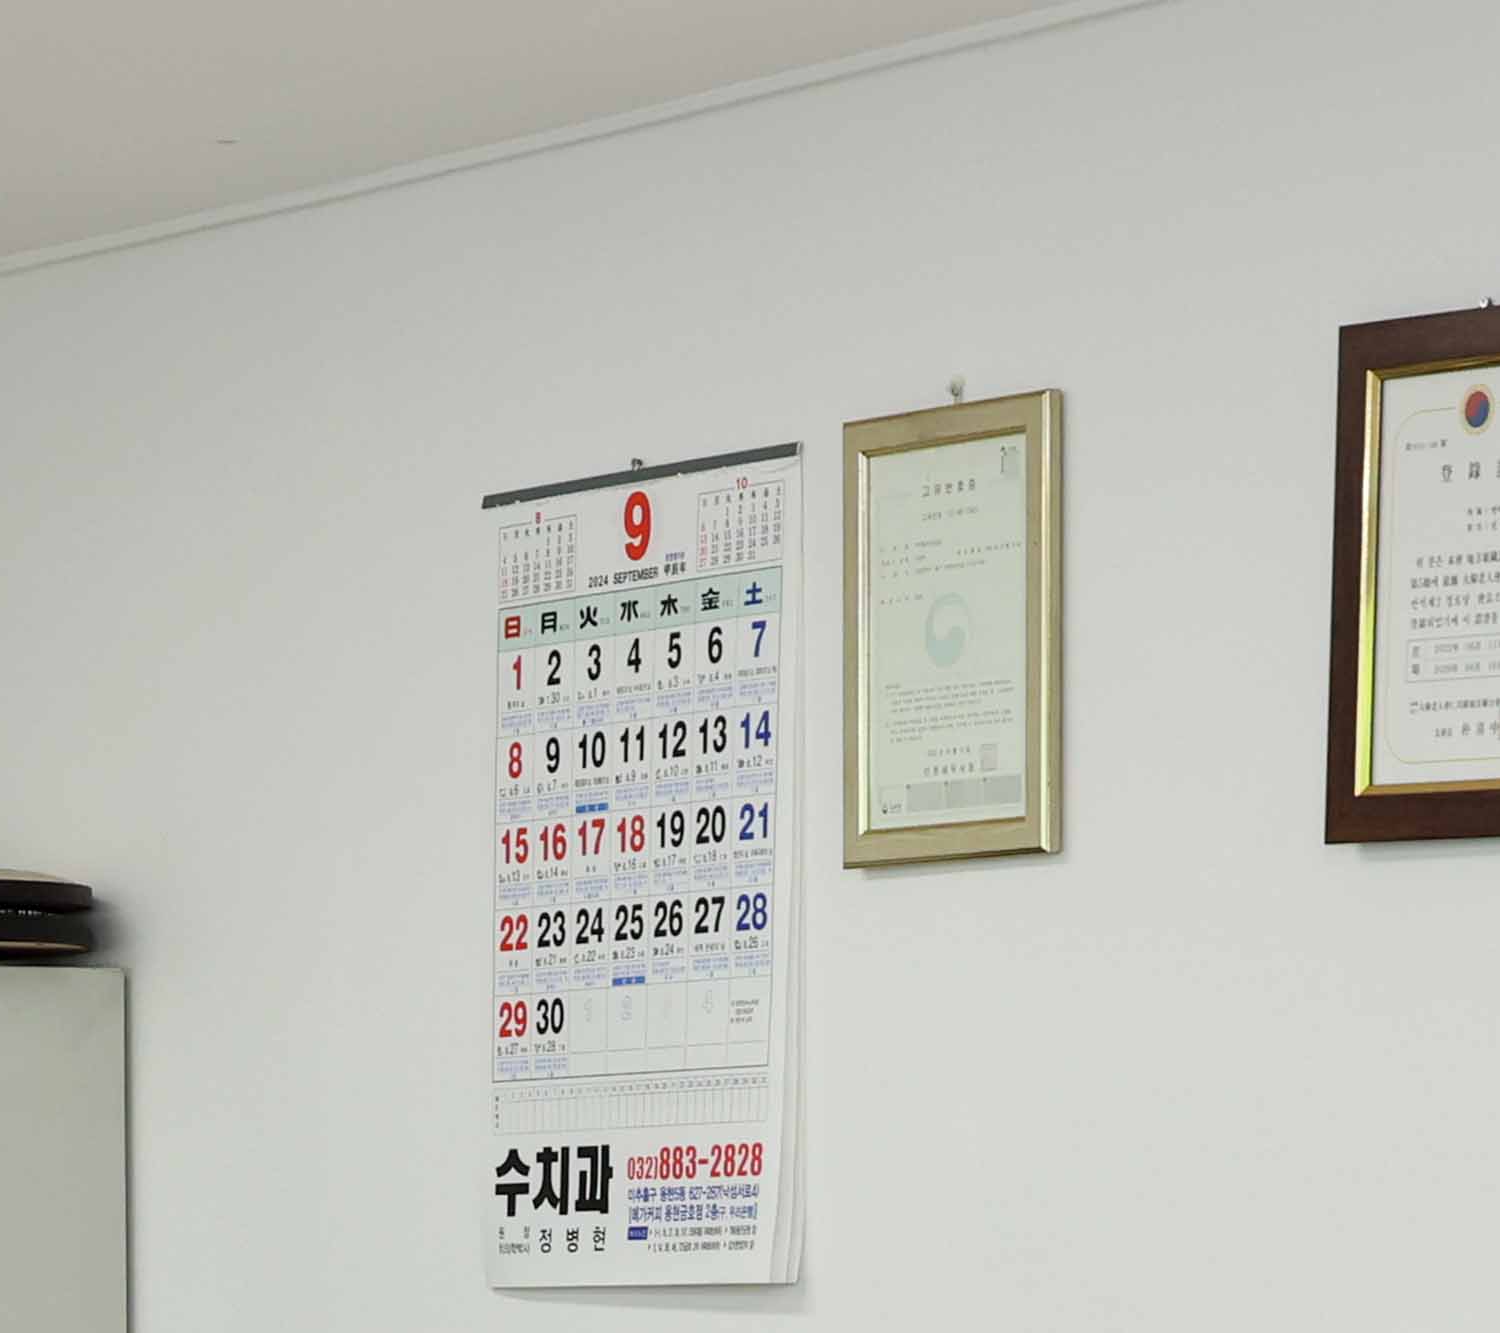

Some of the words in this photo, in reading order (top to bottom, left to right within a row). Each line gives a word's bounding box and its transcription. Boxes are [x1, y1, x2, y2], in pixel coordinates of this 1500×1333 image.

[624, 491, 651, 561] 9
[588, 575, 609, 588] 2024
[613, 566, 659, 585] SEPTEMBER
[505, 616, 520, 639] 日
[541, 611, 557, 634] 月
[580, 606, 598, 629] 火
[620, 600, 638, 622] 水
[660, 594, 678, 616] 木
[701, 588, 720, 611] 金
[744, 582, 763, 606] 土
[513, 655, 521, 690] 1
[547, 650, 561, 686] 2
[588, 644, 601, 680] 3
[627, 638, 641, 673] 4
[668, 632, 681, 668] 5
[708, 627, 722, 664] 6
[752, 620, 766, 657] 7
[509, 742, 522, 778] 8
[546, 737, 560, 773] 9
[579, 731, 605, 768] 10
[620, 726, 644, 763] 11
[659, 721, 686, 759] 12
[699, 715, 726, 754] 13
[741, 711, 771, 749] 14
[502, 828, 528, 864] 15
[540, 824, 566, 861] 16
[578, 819, 605, 856] 17
[617, 815, 645, 853] 18
[657, 810, 684, 848] 19
[696, 806, 725, 844] 20
[739, 803, 768, 840] 21
[500, 914, 528, 951] 22
[538, 911, 565, 948] 23
[576, 908, 604, 944] 24
[615, 904, 643, 941] 25
[654, 900, 682, 938] 26
[694, 896, 725, 934] 27
[736, 893, 767, 931] 28
[499, 1001, 527, 1038] 29
[536, 998, 564, 1035] 30
[495, 1144, 614, 1217] 수치과
[627, 1142, 763, 1181] 032)883-2828
